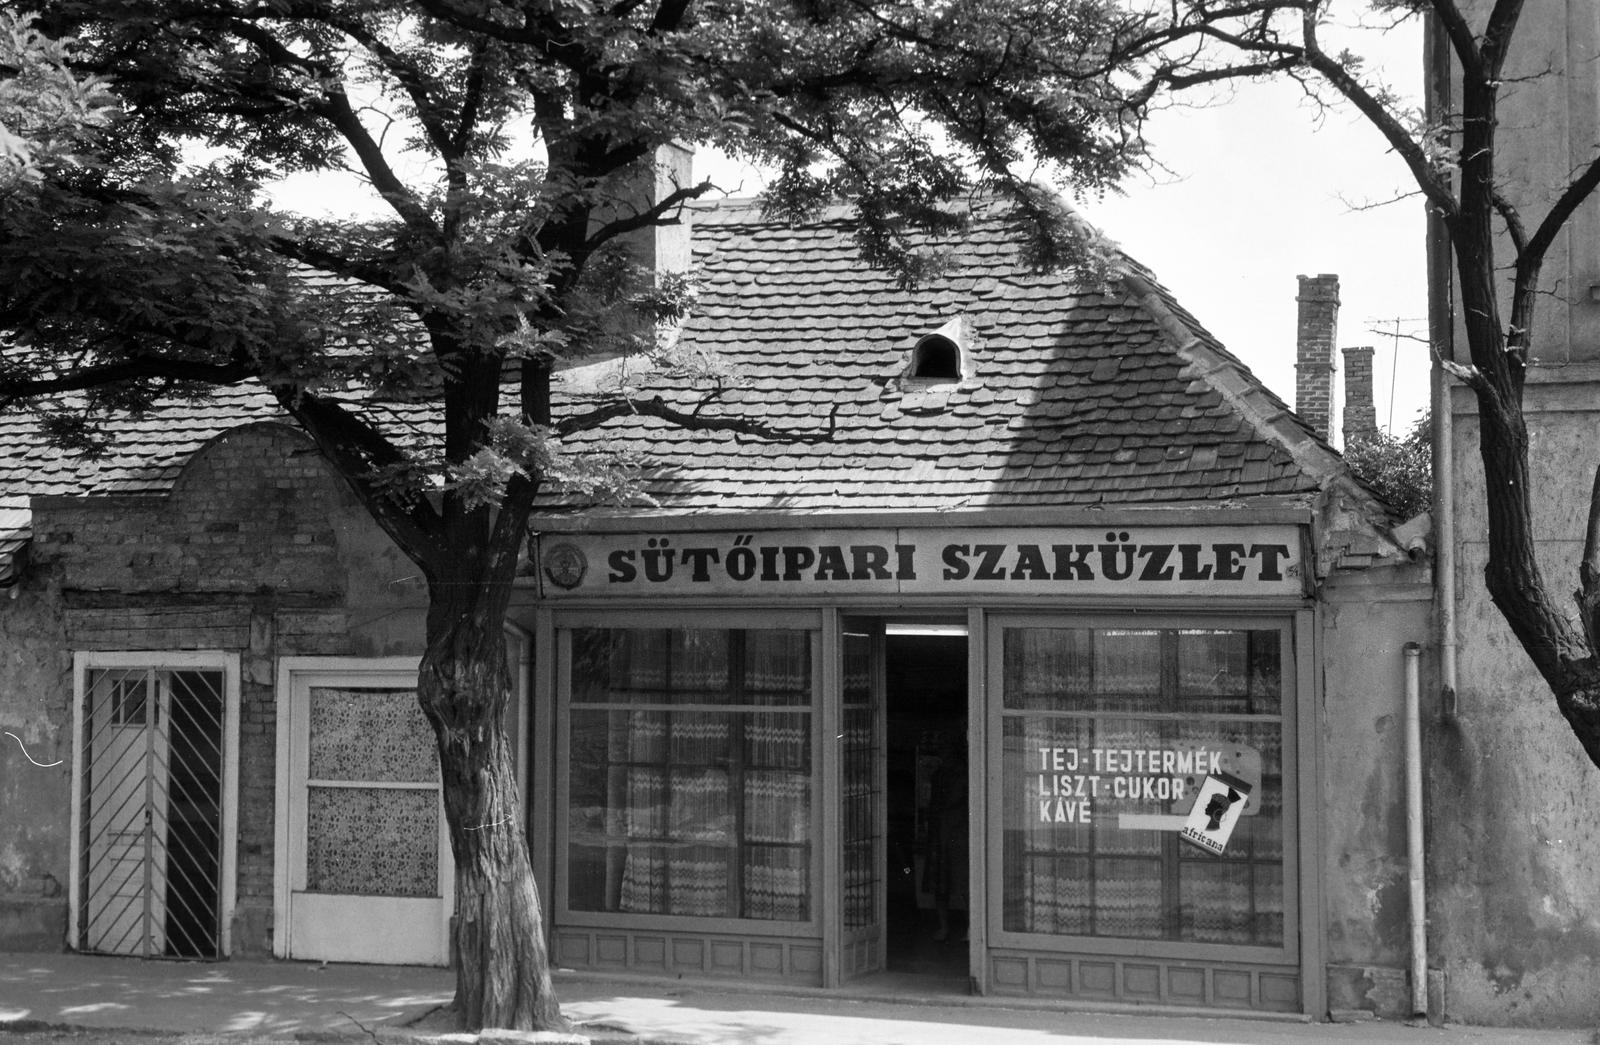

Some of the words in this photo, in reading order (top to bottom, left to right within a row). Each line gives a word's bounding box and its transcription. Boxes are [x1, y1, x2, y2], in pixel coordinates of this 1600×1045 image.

[608, 535, 916, 583] SÜTŐIPARI
[941, 531, 1290, 581] SZAKÜZLET
[1040, 796, 1091, 823] KÁVÉ
[1182, 826, 1224, 852] africana
